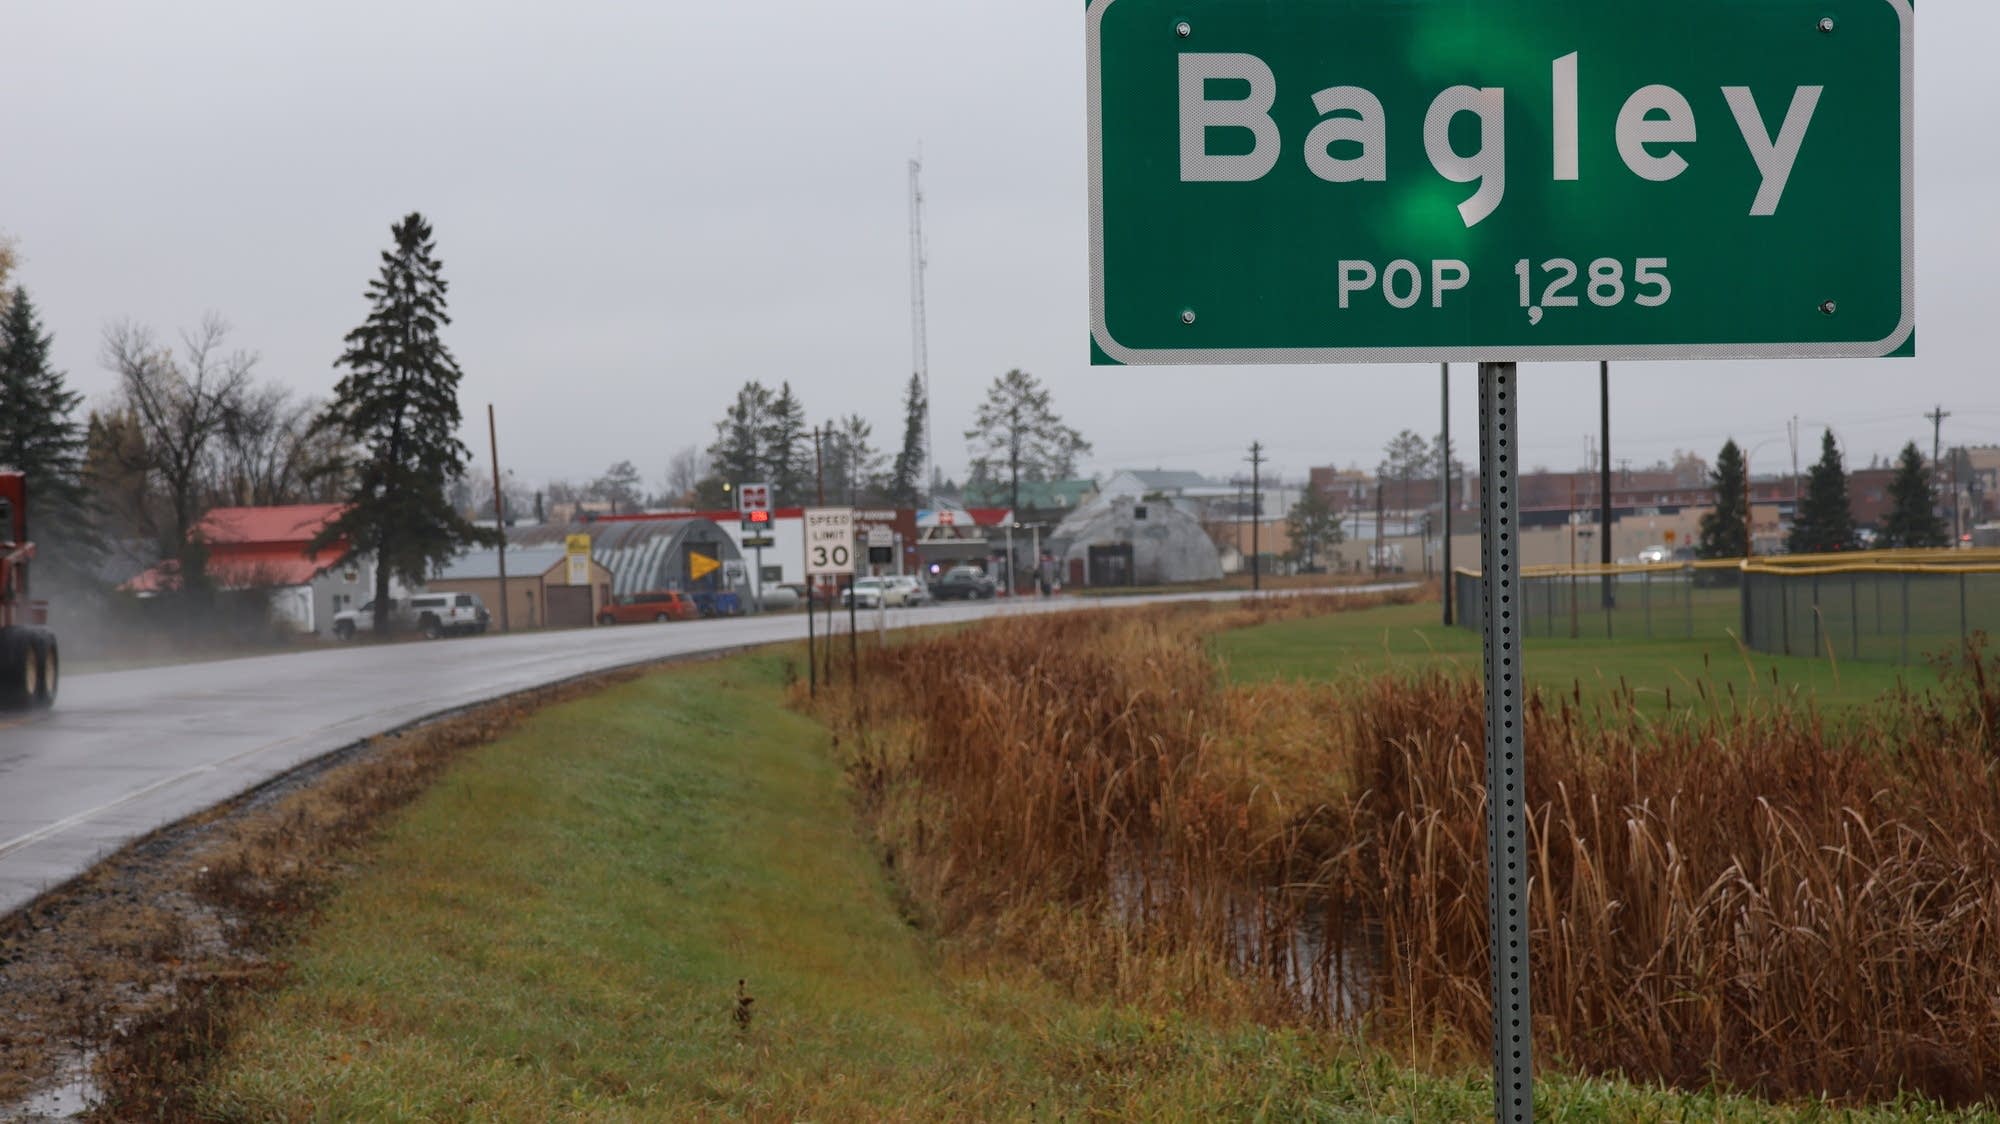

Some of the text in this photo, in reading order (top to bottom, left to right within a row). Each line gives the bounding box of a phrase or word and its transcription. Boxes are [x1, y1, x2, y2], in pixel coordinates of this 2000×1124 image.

[1178, 51, 1825, 229] Bagley
[1338, 257, 1672, 326] POP 1,285
[809, 515, 849, 527] SPEED
[813, 530, 845, 541] LIMIT
[813, 545, 848, 567] 30
